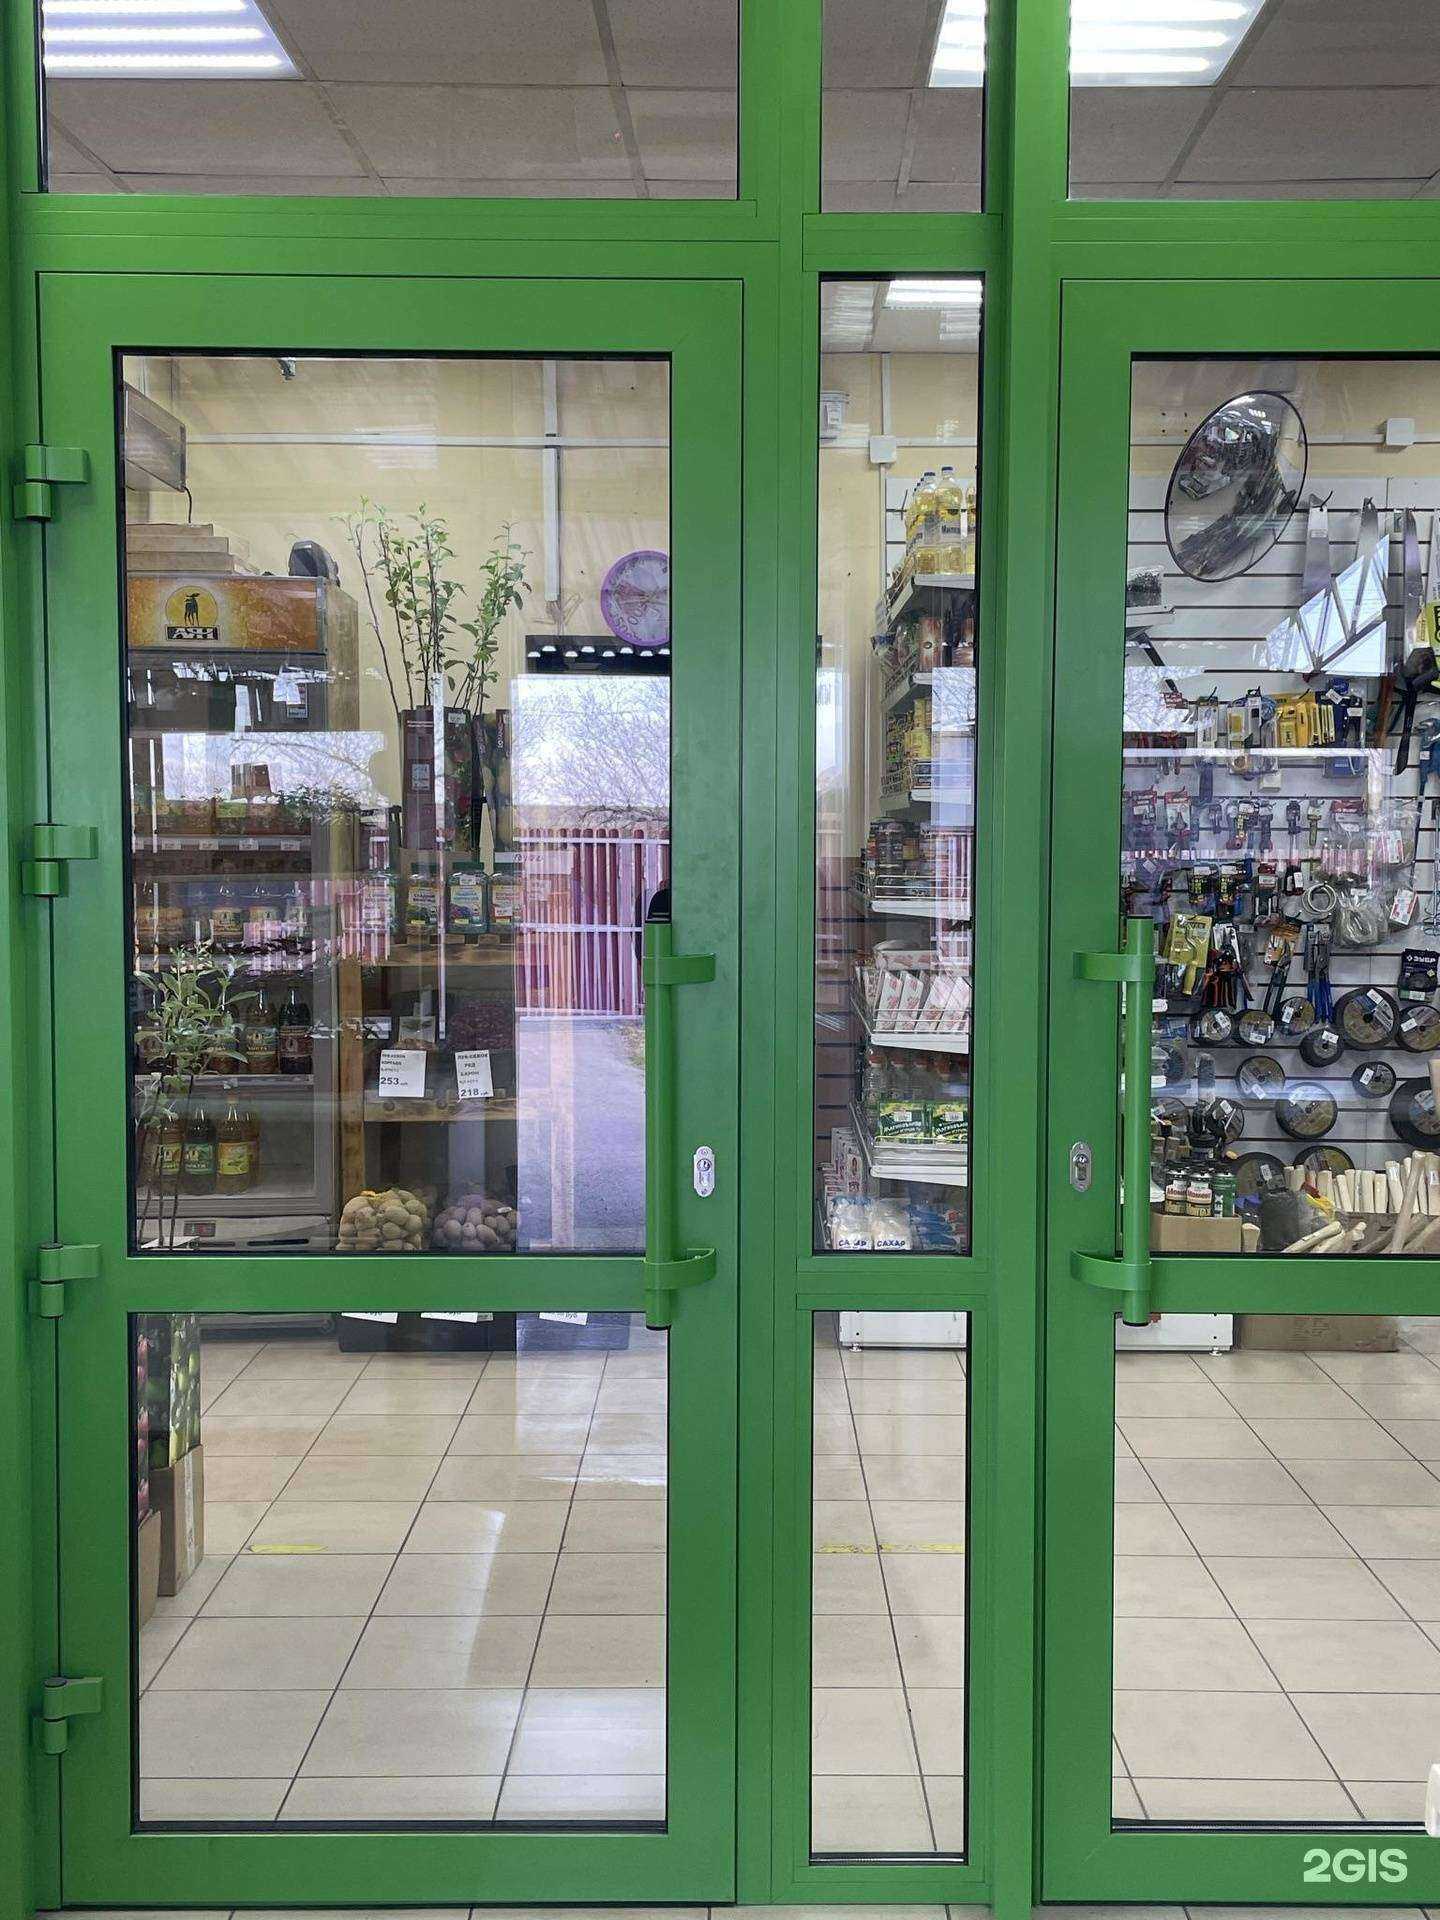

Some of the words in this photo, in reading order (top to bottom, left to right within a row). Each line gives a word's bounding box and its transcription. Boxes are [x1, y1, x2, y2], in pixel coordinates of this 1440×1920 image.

[380, 1077, 399, 1086] 253
[460, 1088, 479, 1097] 218
[876, 1239, 906, 1247] САХАР
